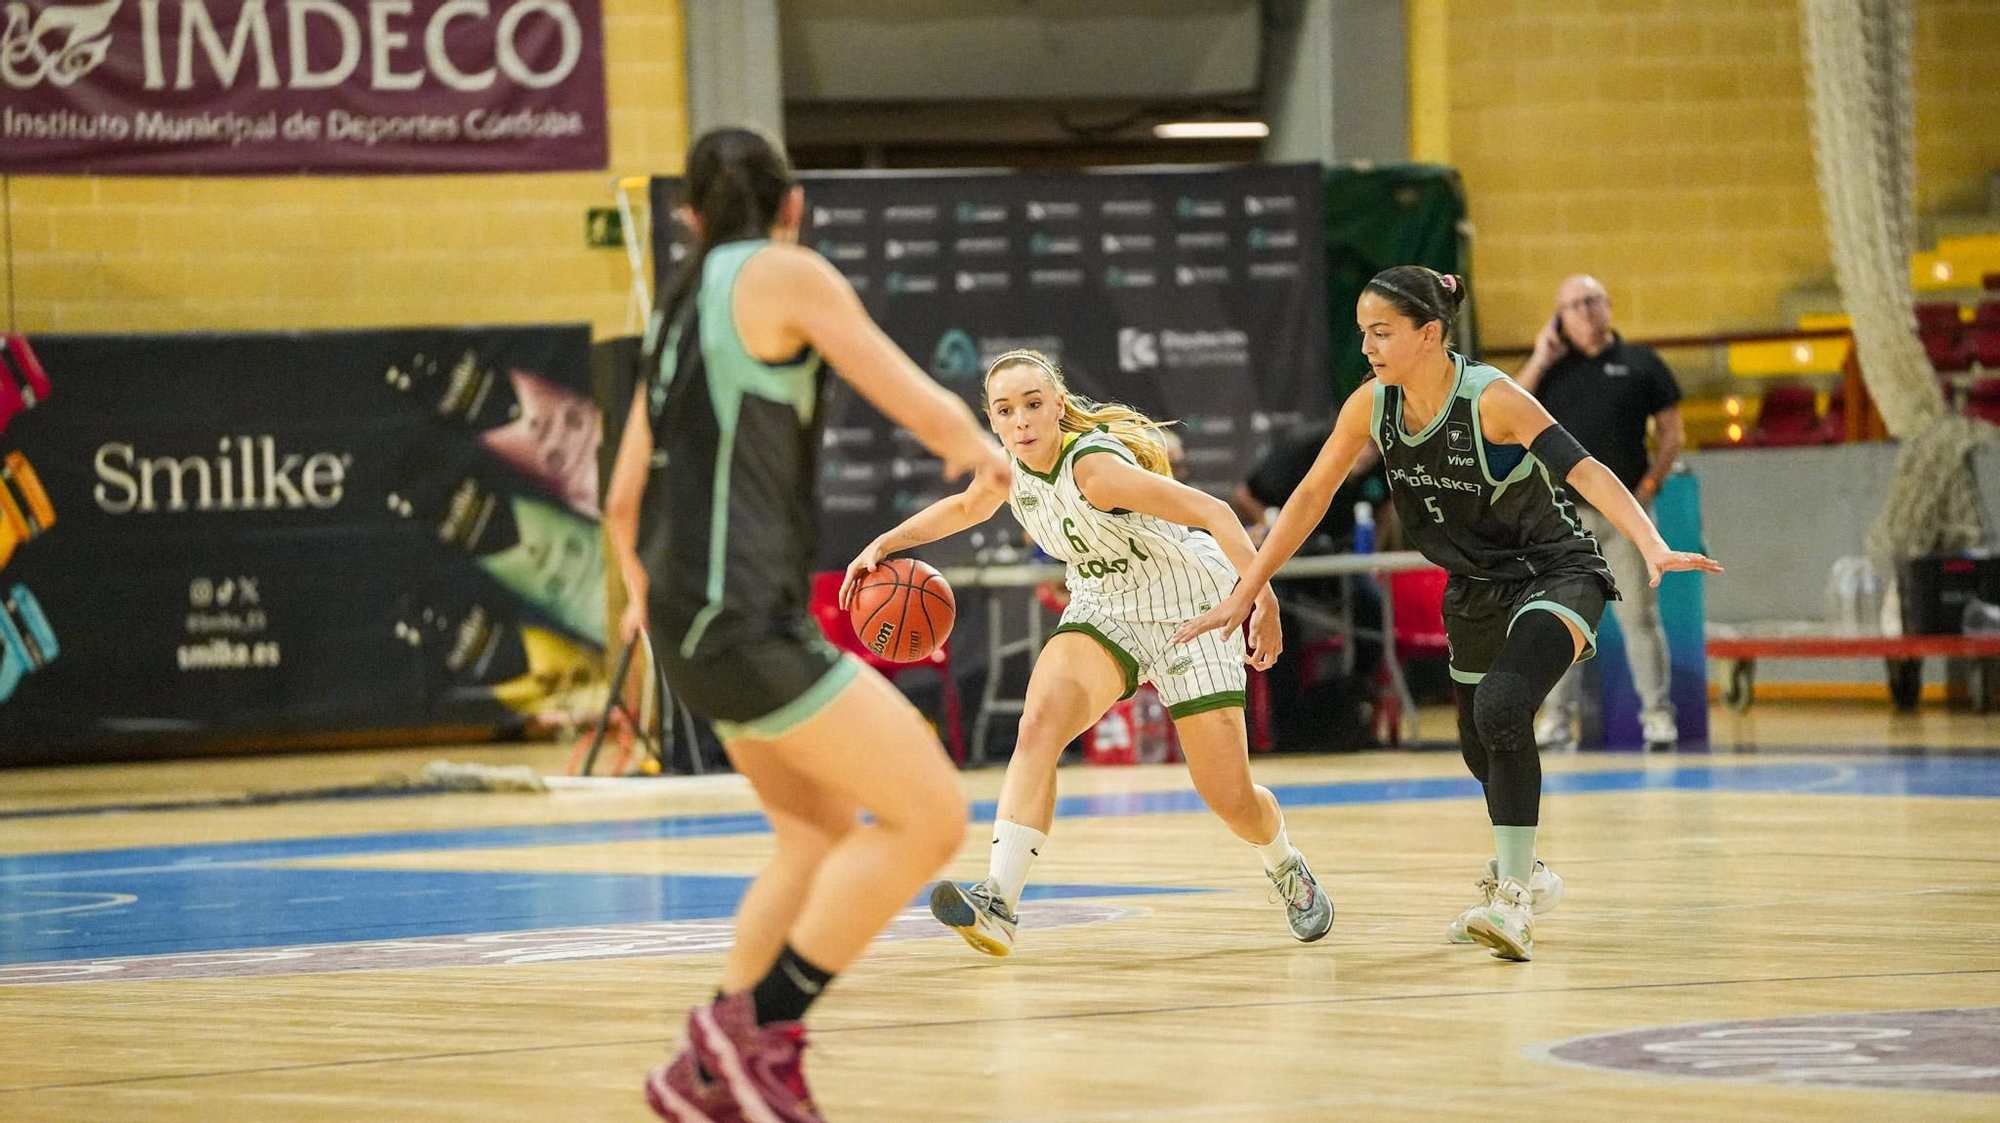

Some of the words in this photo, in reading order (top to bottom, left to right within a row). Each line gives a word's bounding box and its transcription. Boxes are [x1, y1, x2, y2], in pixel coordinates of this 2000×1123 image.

[140, 0, 583, 91] IMDECO
[3, 106, 129, 139] Instituto
[134, 109, 278, 147] Municipal
[282, 109, 321, 141] de
[327, 109, 460, 145] Deportes
[93, 434, 346, 514] Smilke
[1447, 454, 1475, 466] vive
[1424, 496, 1445, 523] 5
[1062, 517, 1089, 554] 6
